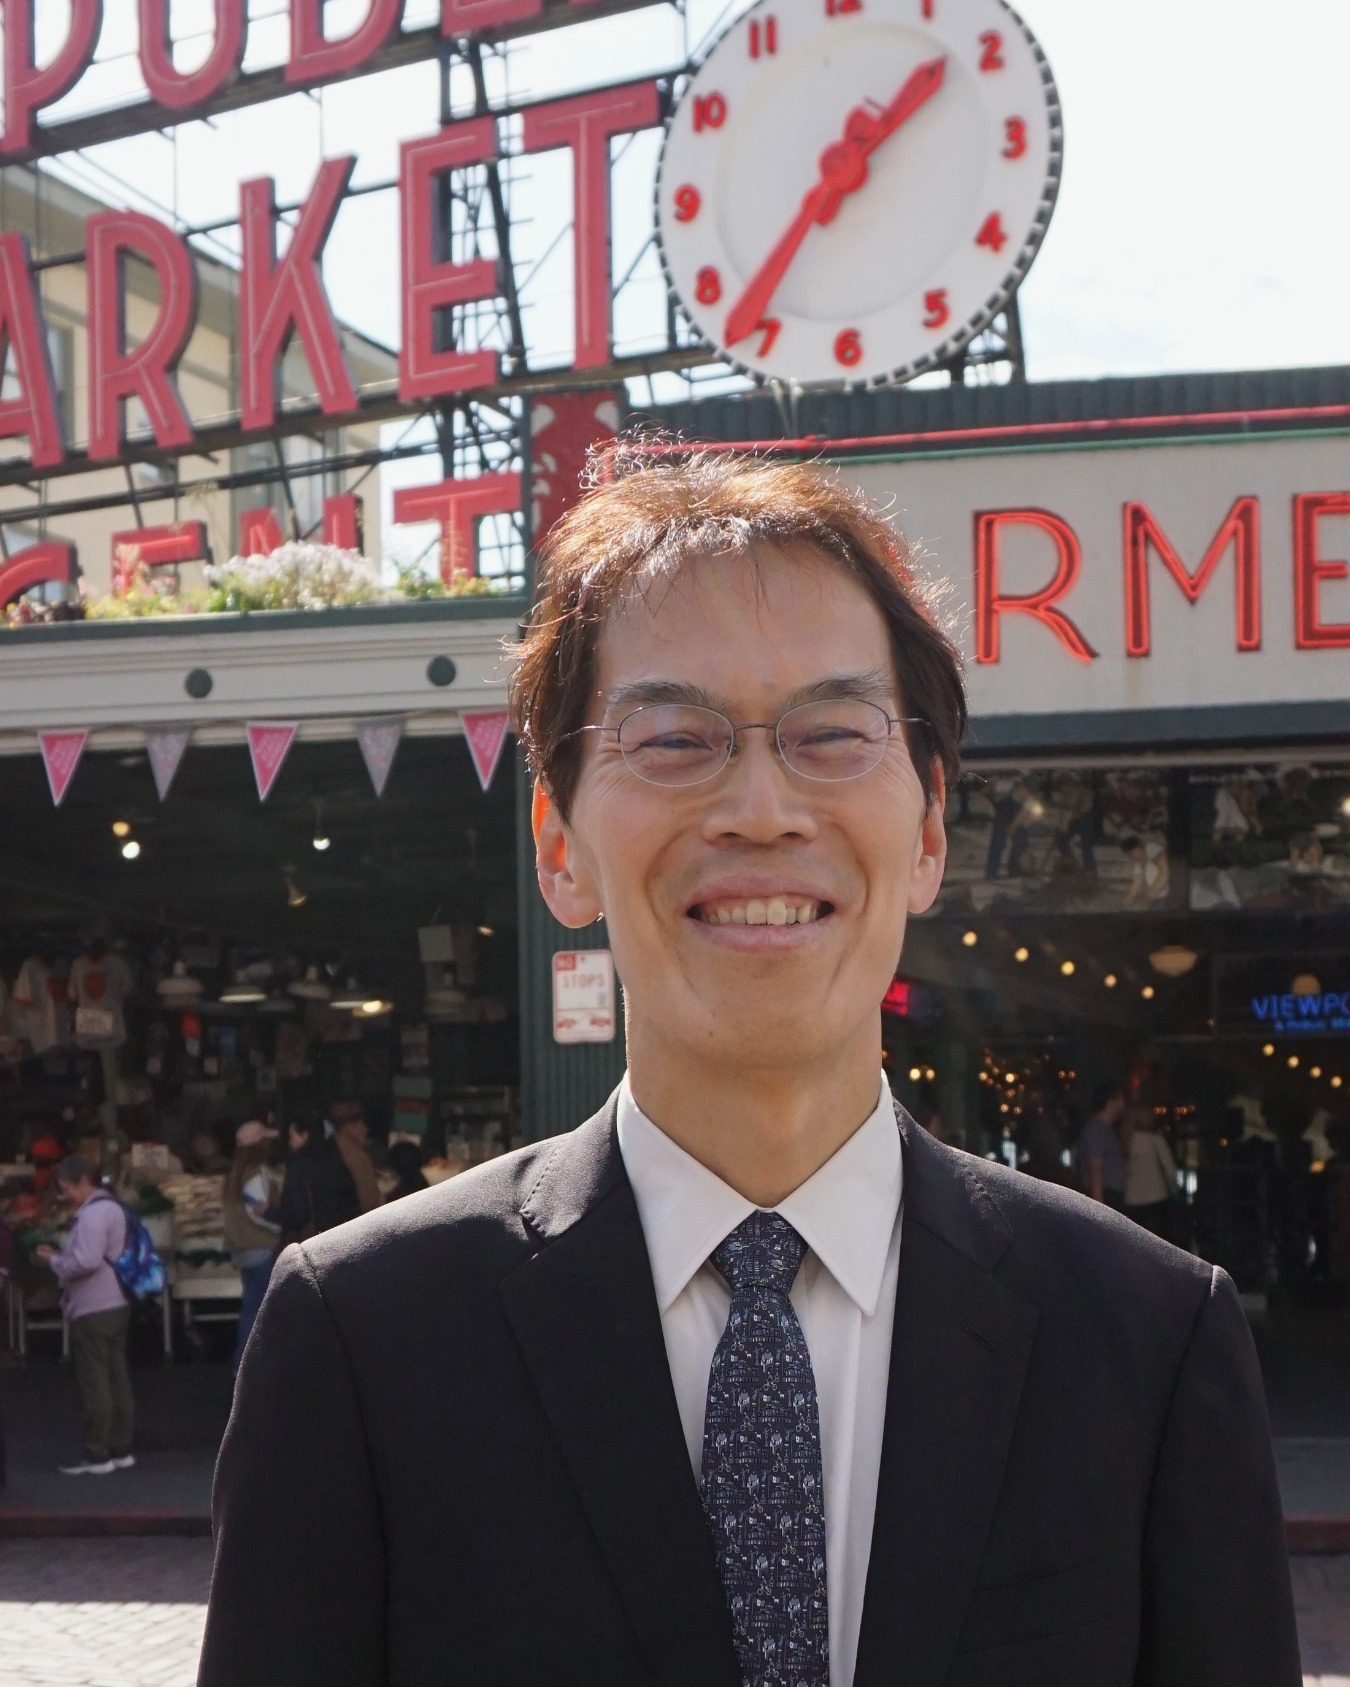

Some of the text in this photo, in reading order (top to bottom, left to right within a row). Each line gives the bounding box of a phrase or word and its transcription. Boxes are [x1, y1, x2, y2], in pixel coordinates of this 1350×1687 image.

[748, 17, 778, 59] 11
[979, 31, 1003, 73] 2
[693, 92, 728, 133] 10
[1001, 116, 1028, 160] 3
[674, 184, 701, 223] 9
[975, 212, 1008, 253] 4
[695, 266, 722, 306] 8
[923, 289, 950, 330] 5
[754, 318, 782, 358] 7
[834, 329, 863, 368] 6
